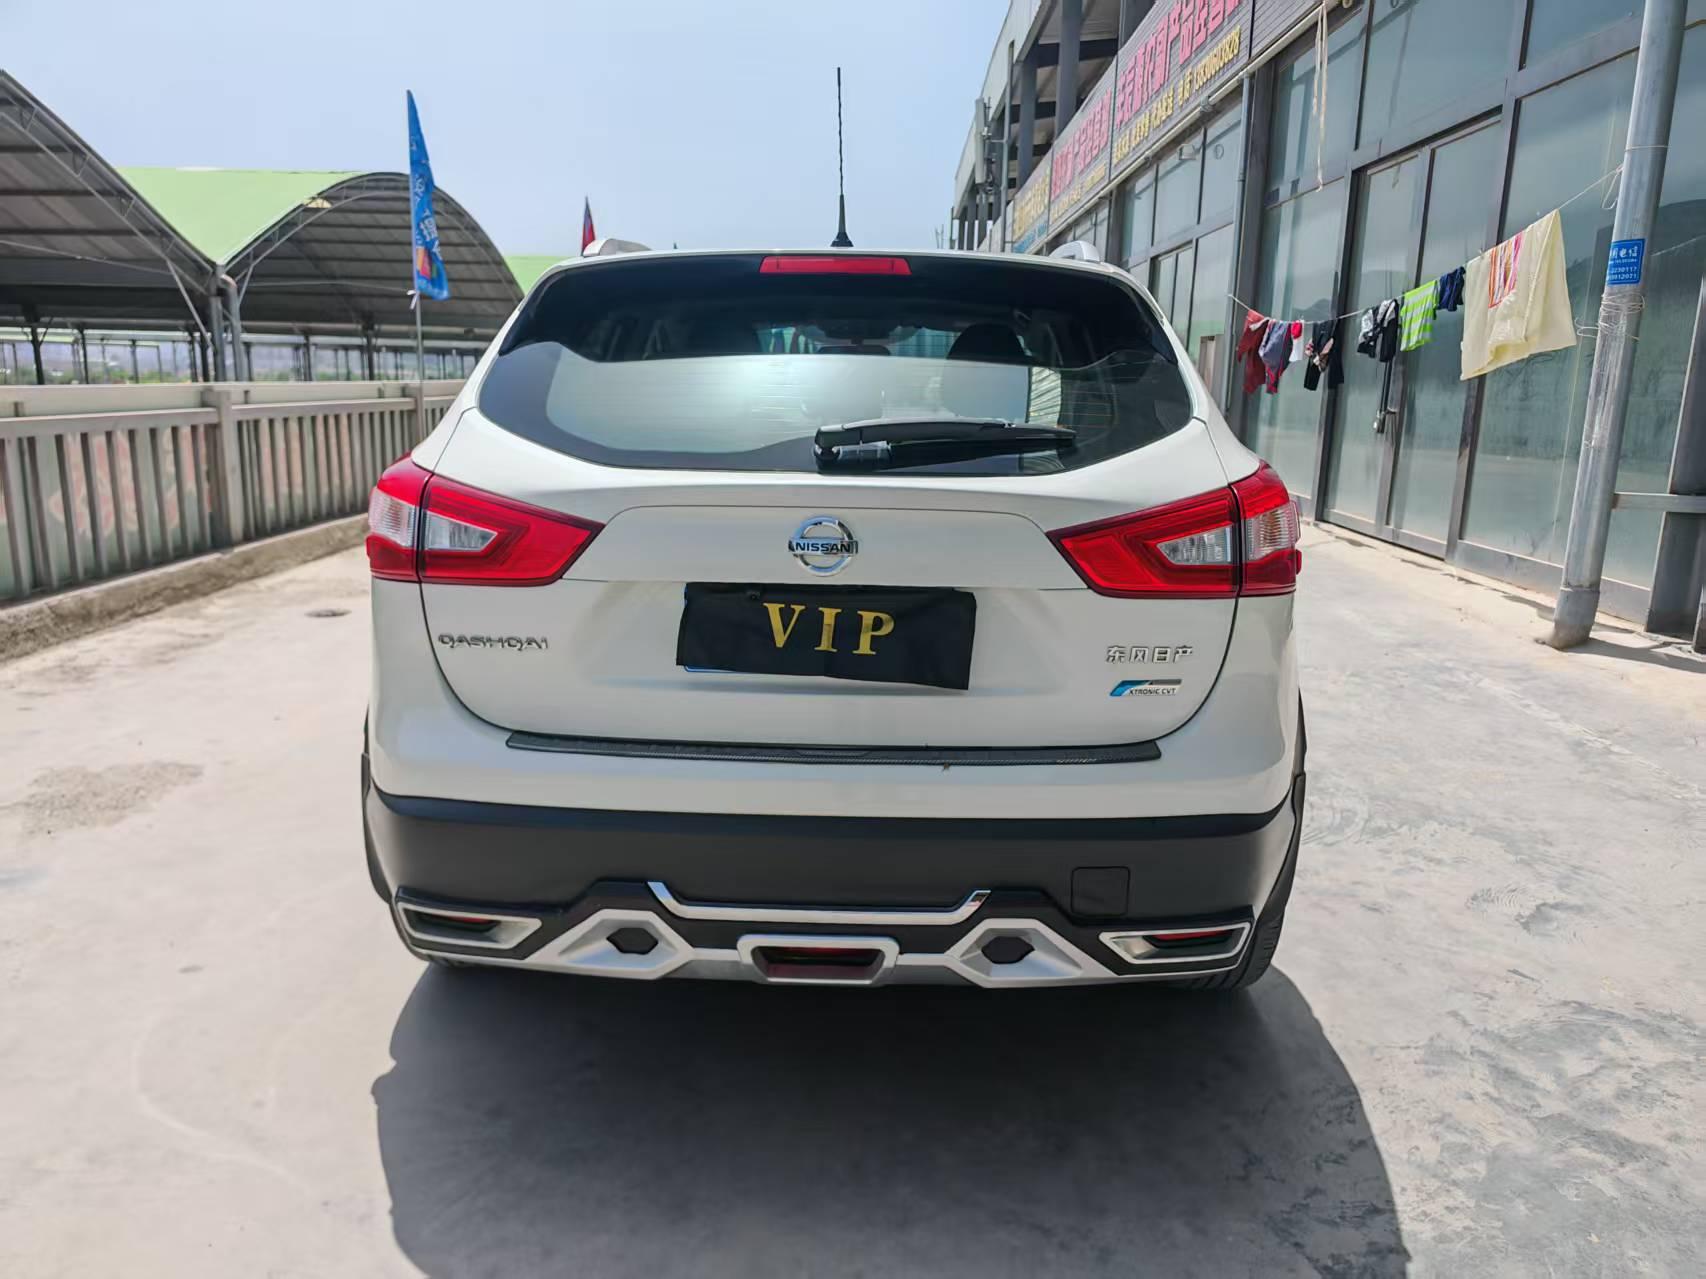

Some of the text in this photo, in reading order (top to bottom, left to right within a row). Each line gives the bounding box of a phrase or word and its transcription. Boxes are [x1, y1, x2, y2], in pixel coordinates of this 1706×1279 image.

[795, 541, 852, 553] NISSAN
[762, 602, 895, 656] VIP
[438, 634, 549, 652] QASHQAI
[1106, 645, 1193, 664] 东风日产
[1128, 687, 1178, 696] XTRONIC CVT
